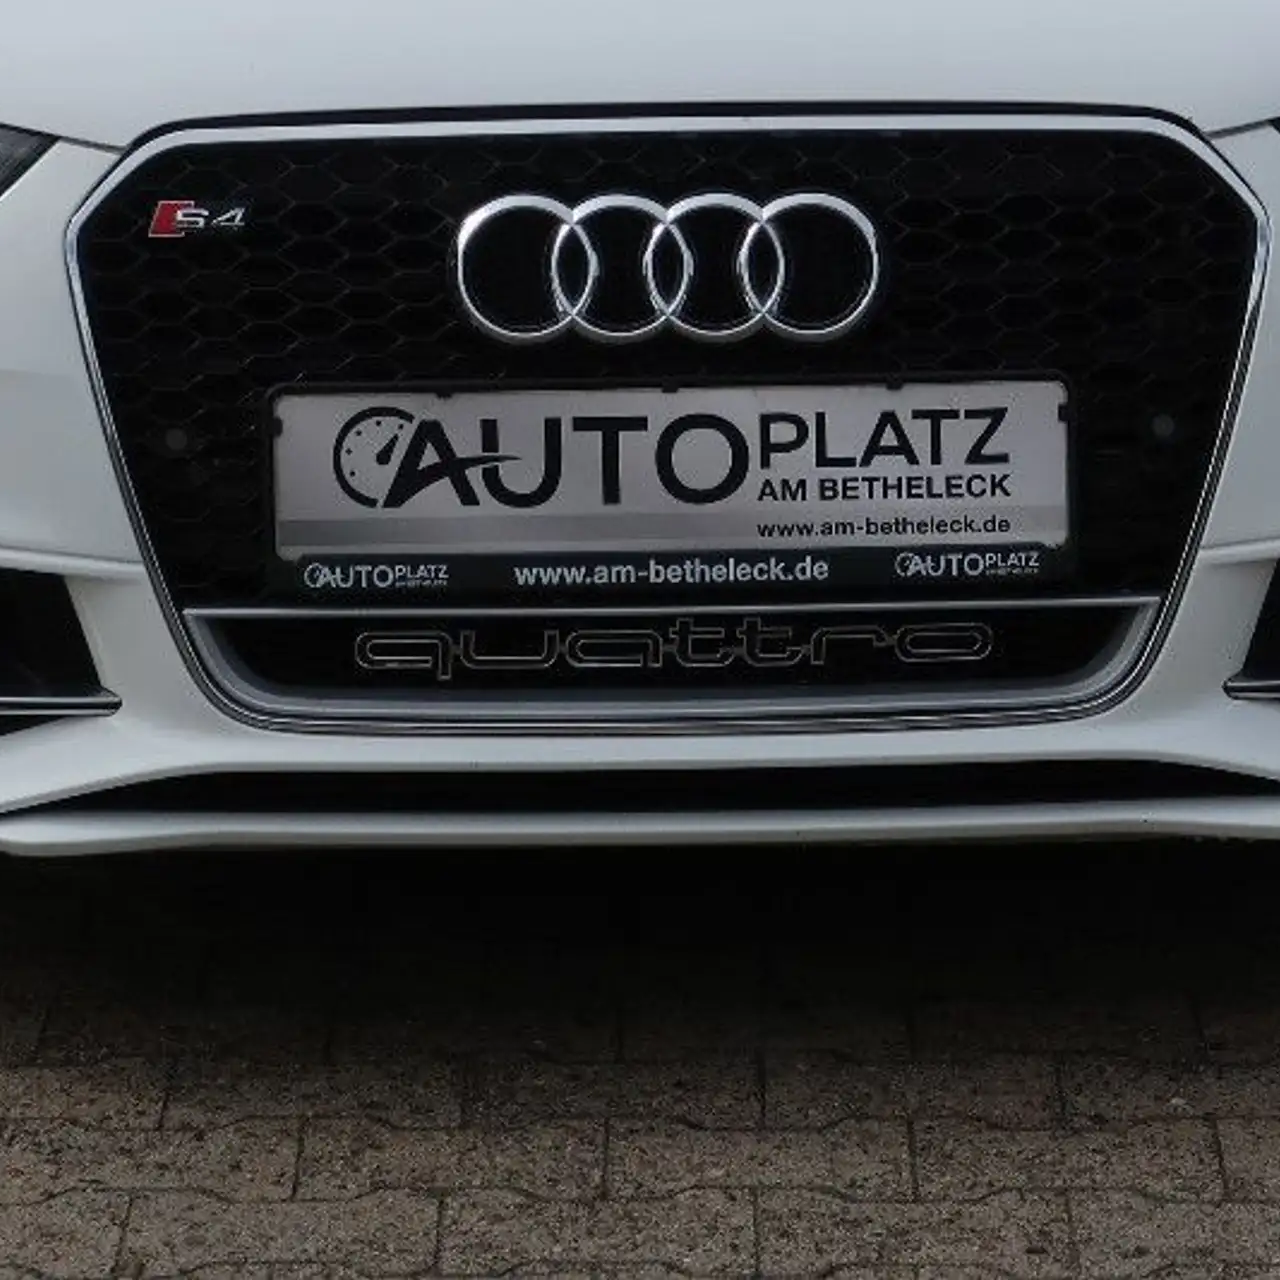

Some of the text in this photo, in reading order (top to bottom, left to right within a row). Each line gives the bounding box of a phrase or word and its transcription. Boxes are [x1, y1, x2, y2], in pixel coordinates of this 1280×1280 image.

[756, 473, 1012, 502] AM BETHELECK
[756, 515, 1012, 538] www.am-betheleck.de
[514, 555, 830, 586] www.am-betheleck.de
[354, 616, 994, 681] quattro
